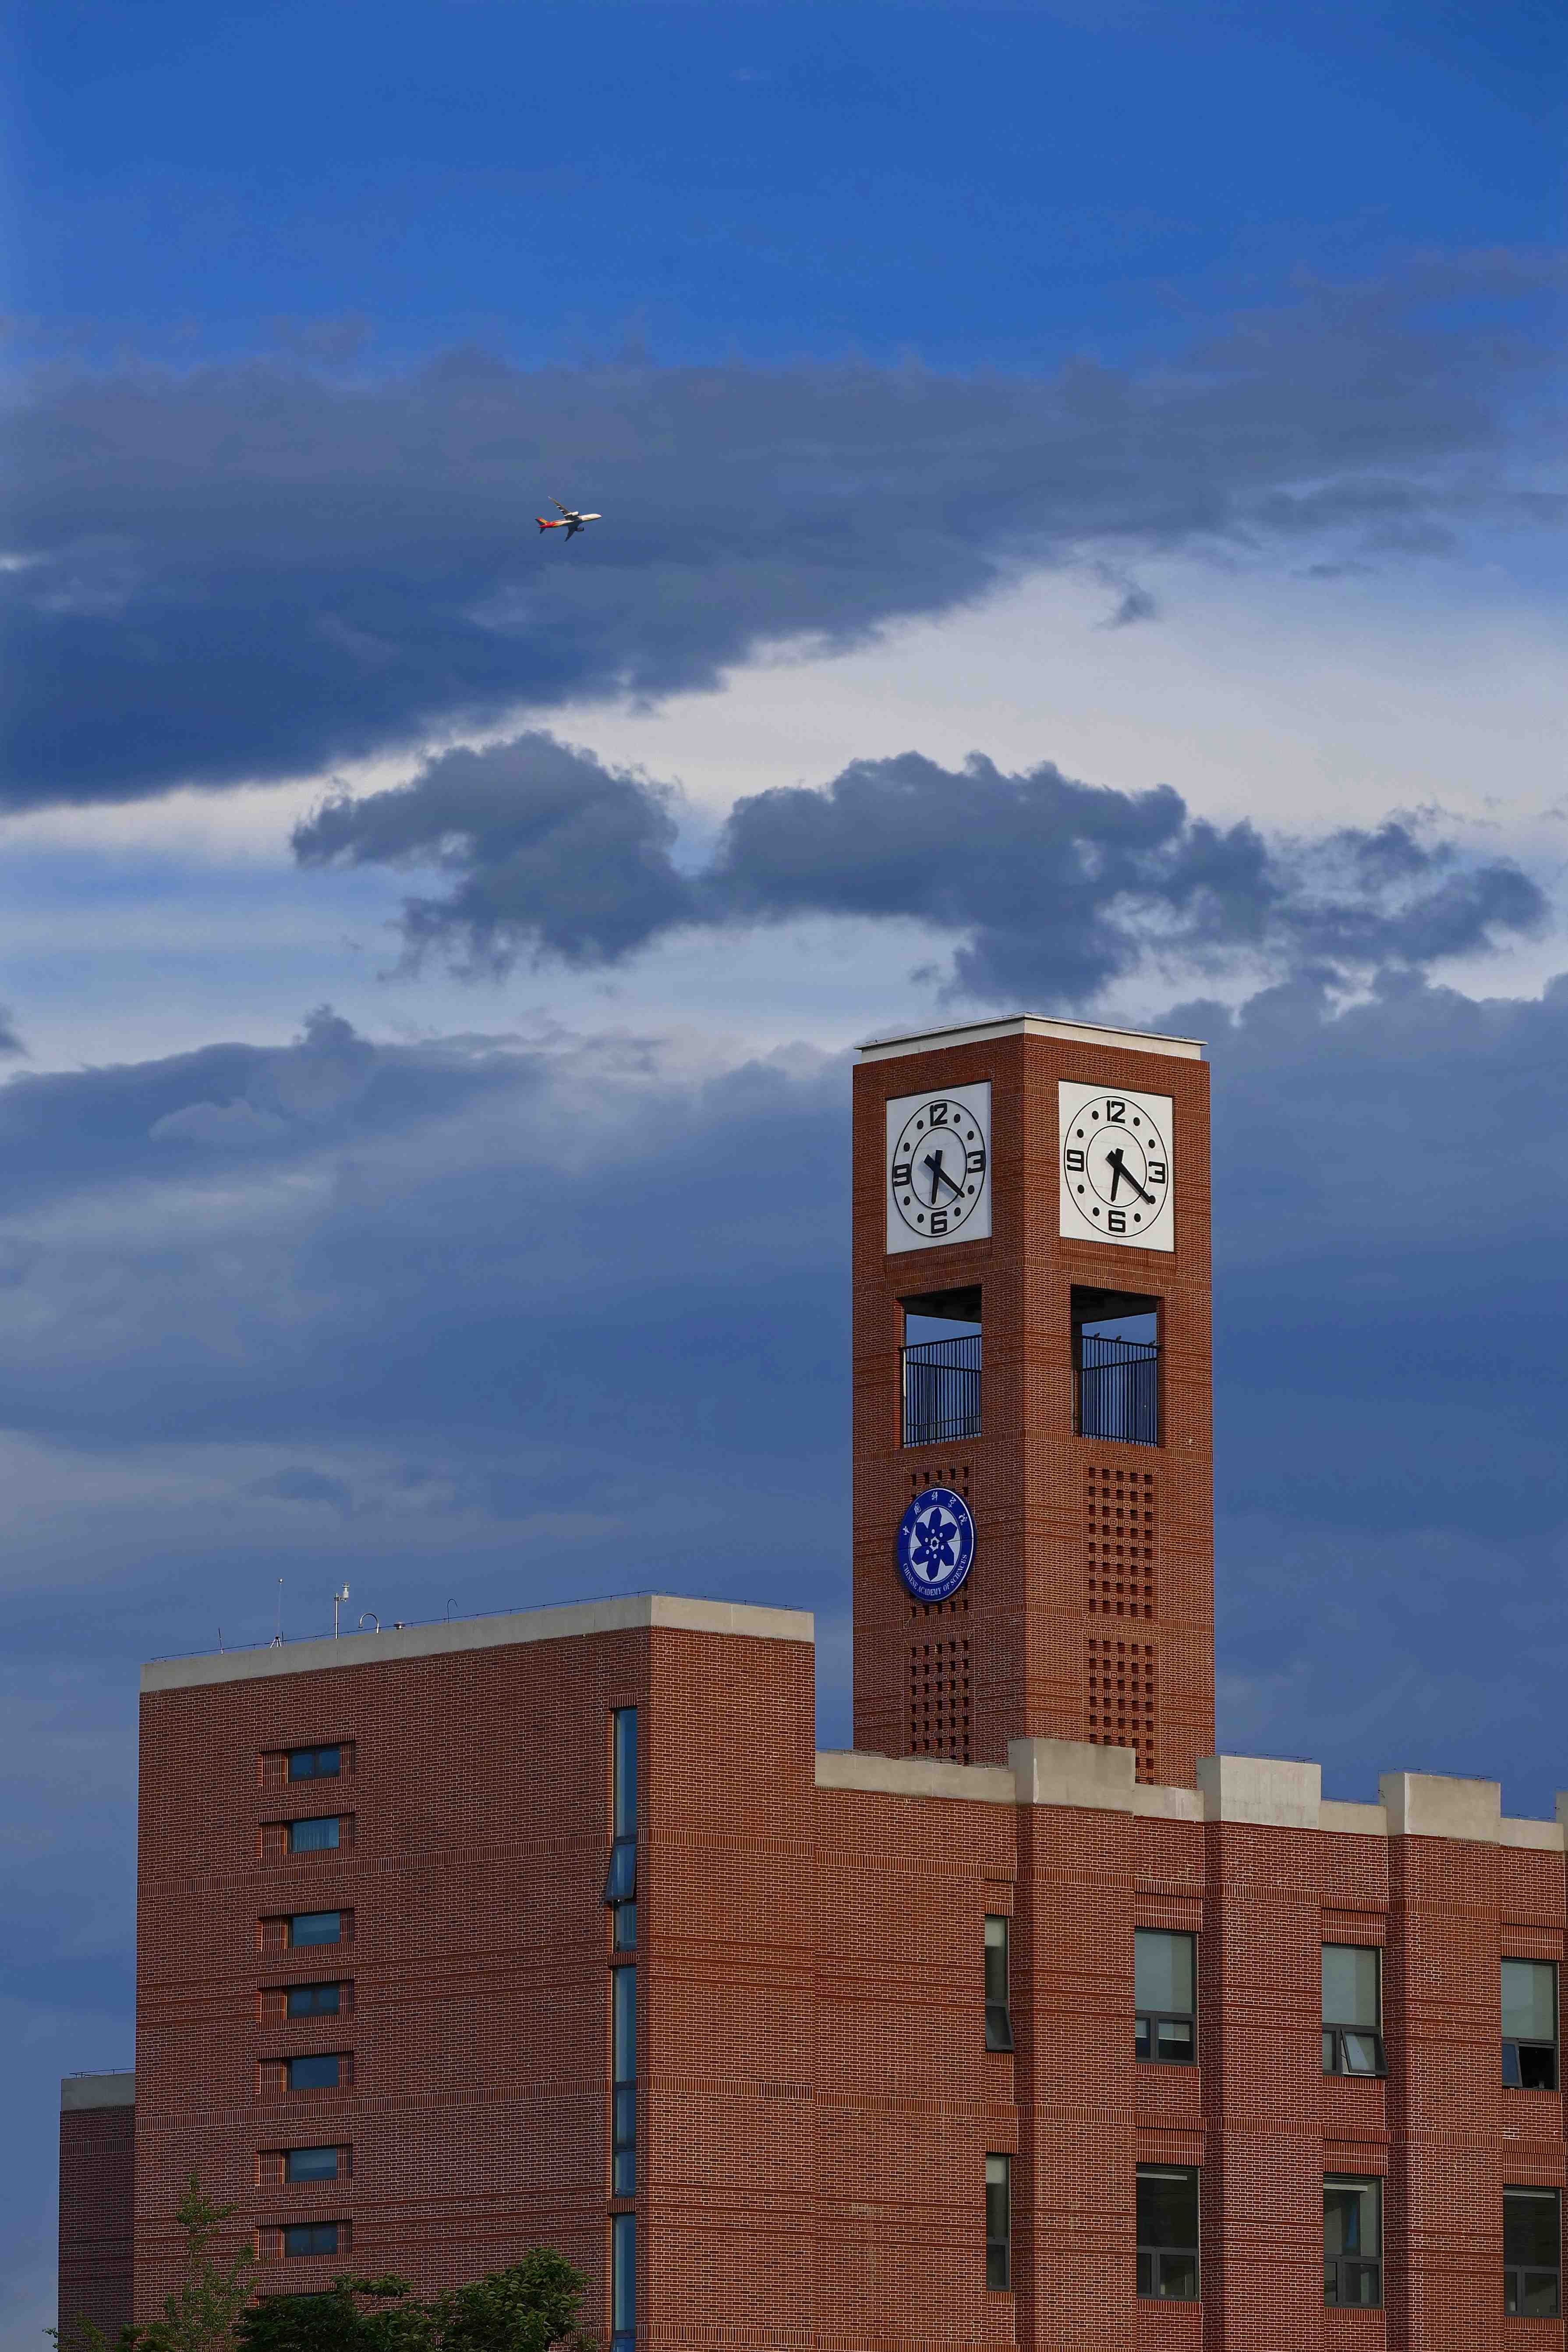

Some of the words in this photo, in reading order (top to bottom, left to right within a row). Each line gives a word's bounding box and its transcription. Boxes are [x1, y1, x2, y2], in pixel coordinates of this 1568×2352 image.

[930, 1103, 948, 1126] 12
[1106, 1100, 1126, 1123] 12
[967, 1150, 985, 1174] 3
[1067, 1149, 1084, 1172] 9
[894, 1163, 910, 1187] 9
[1148, 1162, 1165, 1184] 3
[931, 1210, 947, 1233] 6
[1108, 1210, 1126, 1233] 6
[903, 1563, 919, 1590] CHINESE
[917, 1586, 942, 1596] ACADEMY
[943, 1582, 950, 1591] OF
[950, 1554, 967, 1586] SCIENCES
